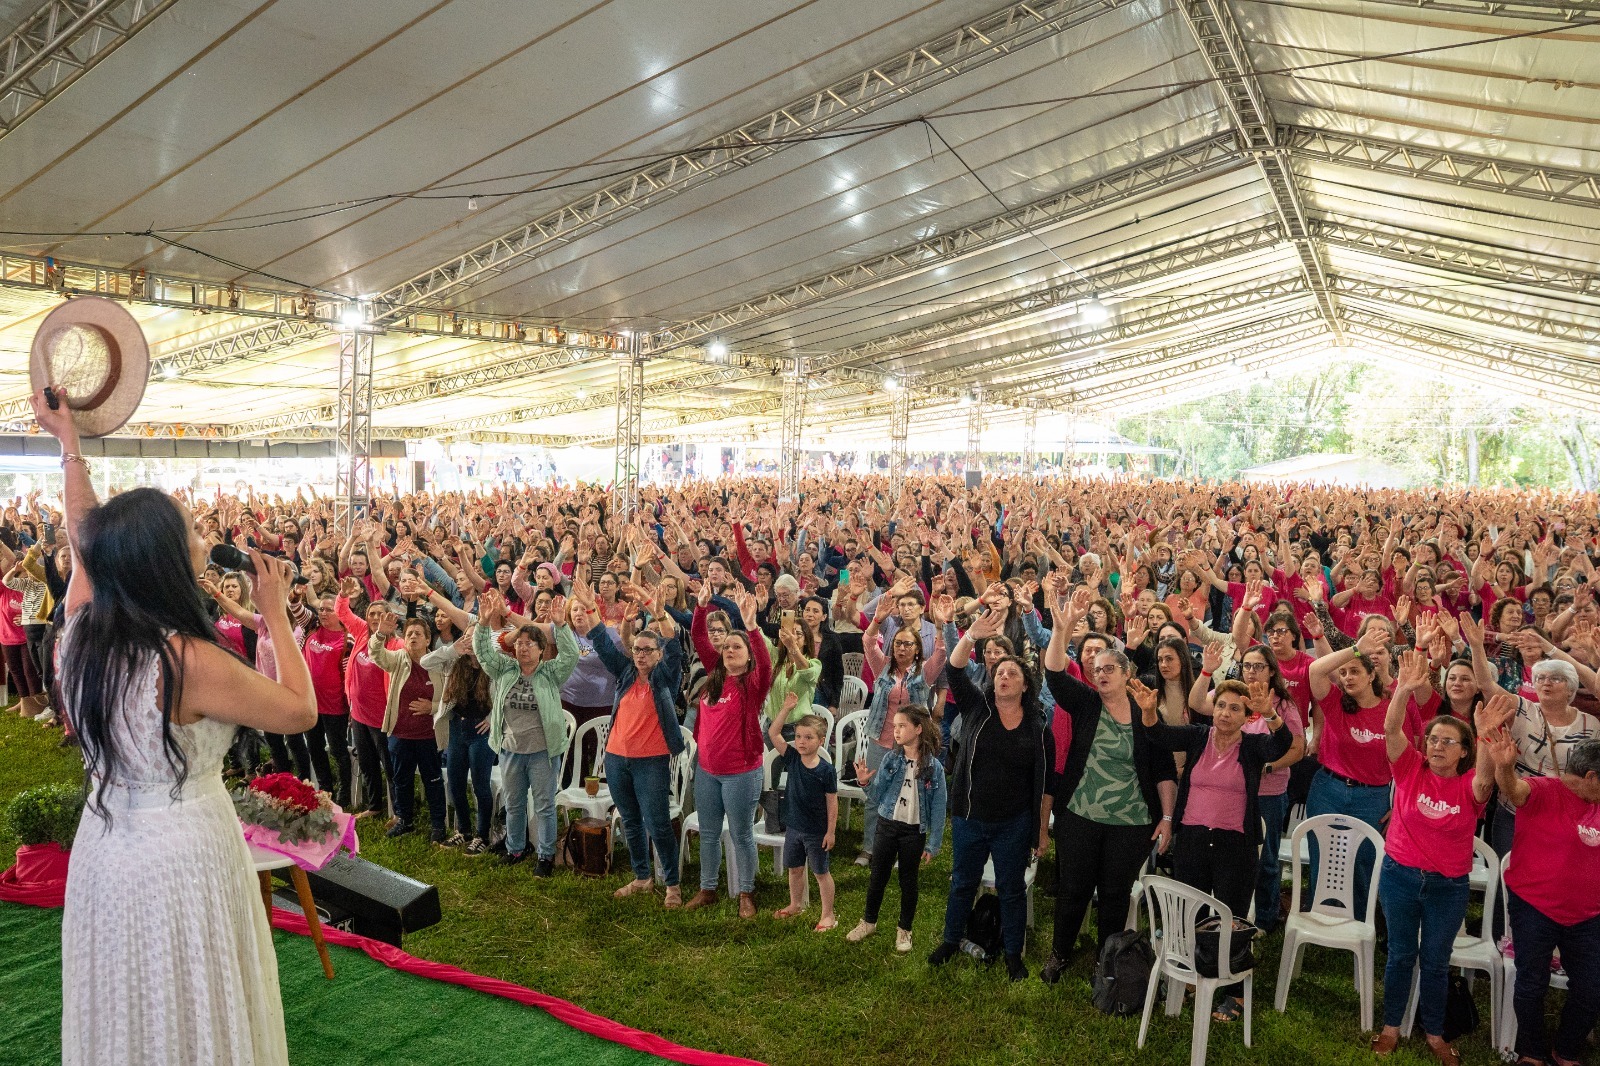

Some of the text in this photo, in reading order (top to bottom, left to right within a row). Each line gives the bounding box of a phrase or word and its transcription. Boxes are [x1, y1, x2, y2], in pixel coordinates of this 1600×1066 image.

[506, 692, 535, 702] ALO
[510, 701, 538, 711] RIES
[1350, 726, 1386, 740] Mulher
